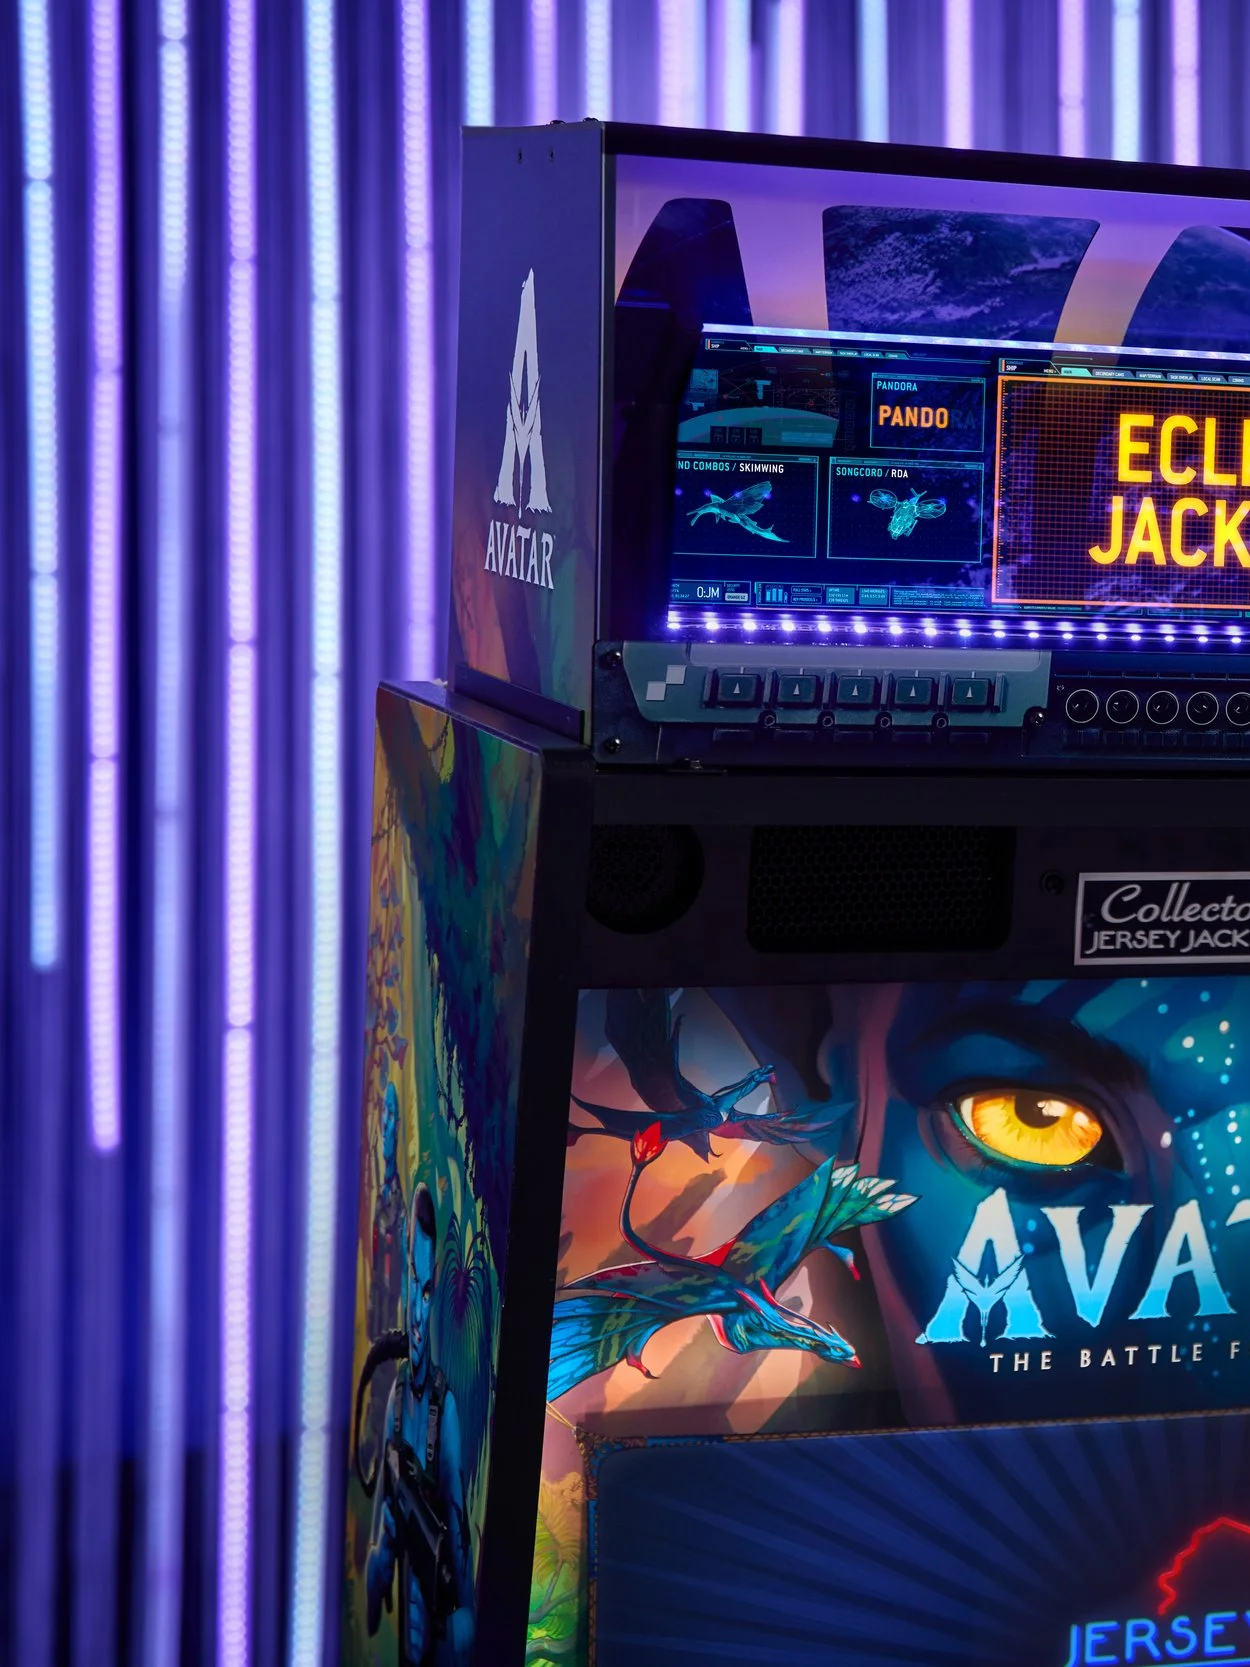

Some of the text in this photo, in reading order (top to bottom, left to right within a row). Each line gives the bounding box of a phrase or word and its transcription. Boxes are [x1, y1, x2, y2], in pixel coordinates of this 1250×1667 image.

[876, 380, 918, 392] PANDORA
[693, 461, 730, 472] COMBOS
[739, 463, 784, 474] SKIMWING
[836, 467, 883, 478] SONGCORD
[891, 468, 908, 479] RDA
[484, 519, 554, 590] AVATAR
[1085, 929, 1181, 954] JERSEY
[1180, 929, 1250, 953] JACK
[989, 1350, 1052, 1374] THE
[1079, 1341, 1204, 1370] BATTLE
